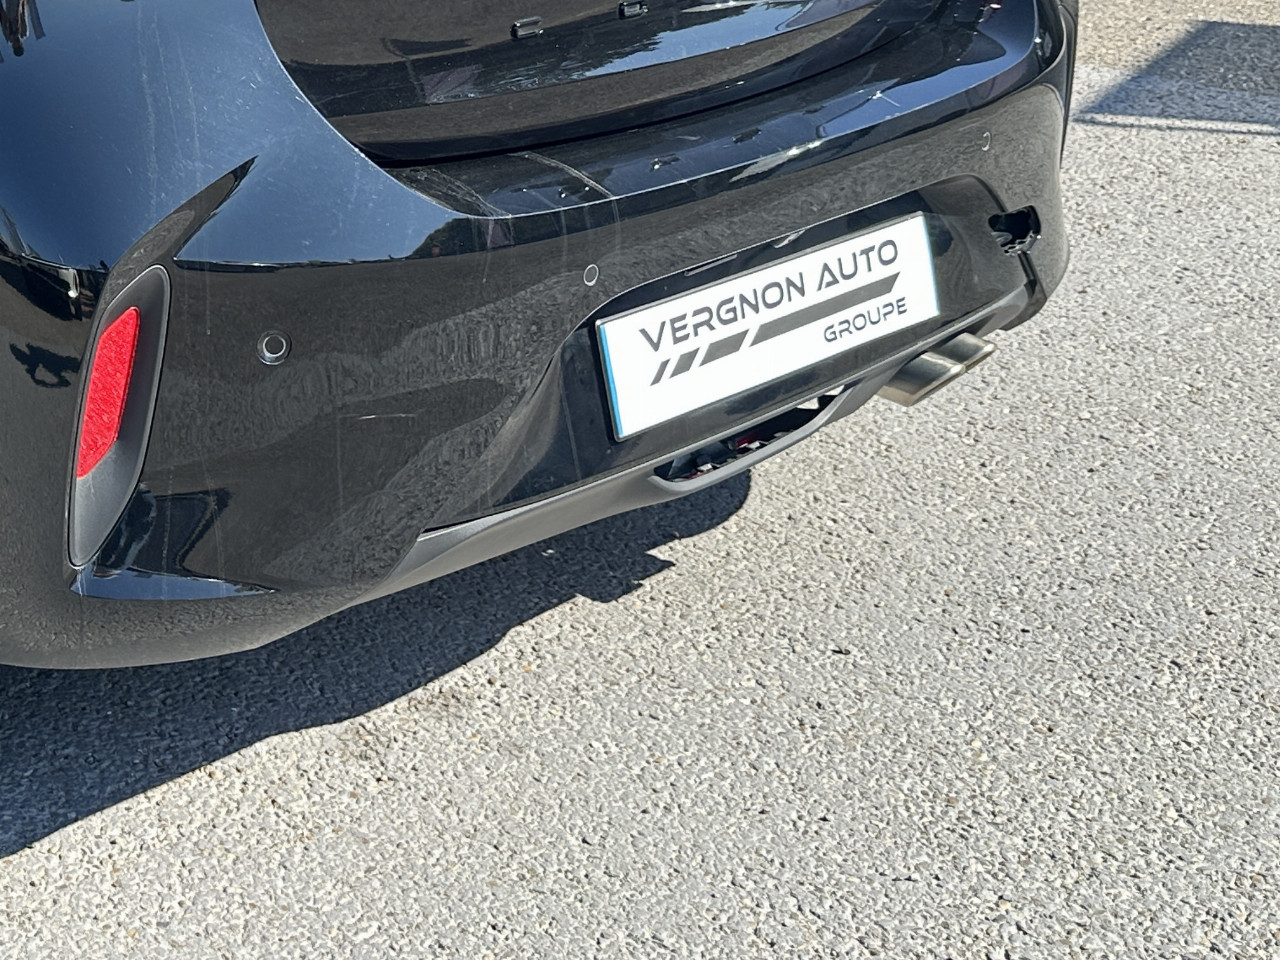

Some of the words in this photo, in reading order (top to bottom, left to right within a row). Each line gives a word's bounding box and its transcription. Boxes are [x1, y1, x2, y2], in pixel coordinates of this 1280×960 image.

[639, 271, 806, 353] VERGNON
[816, 239, 899, 292] AUTO
[823, 296, 909, 343] GROUPE
